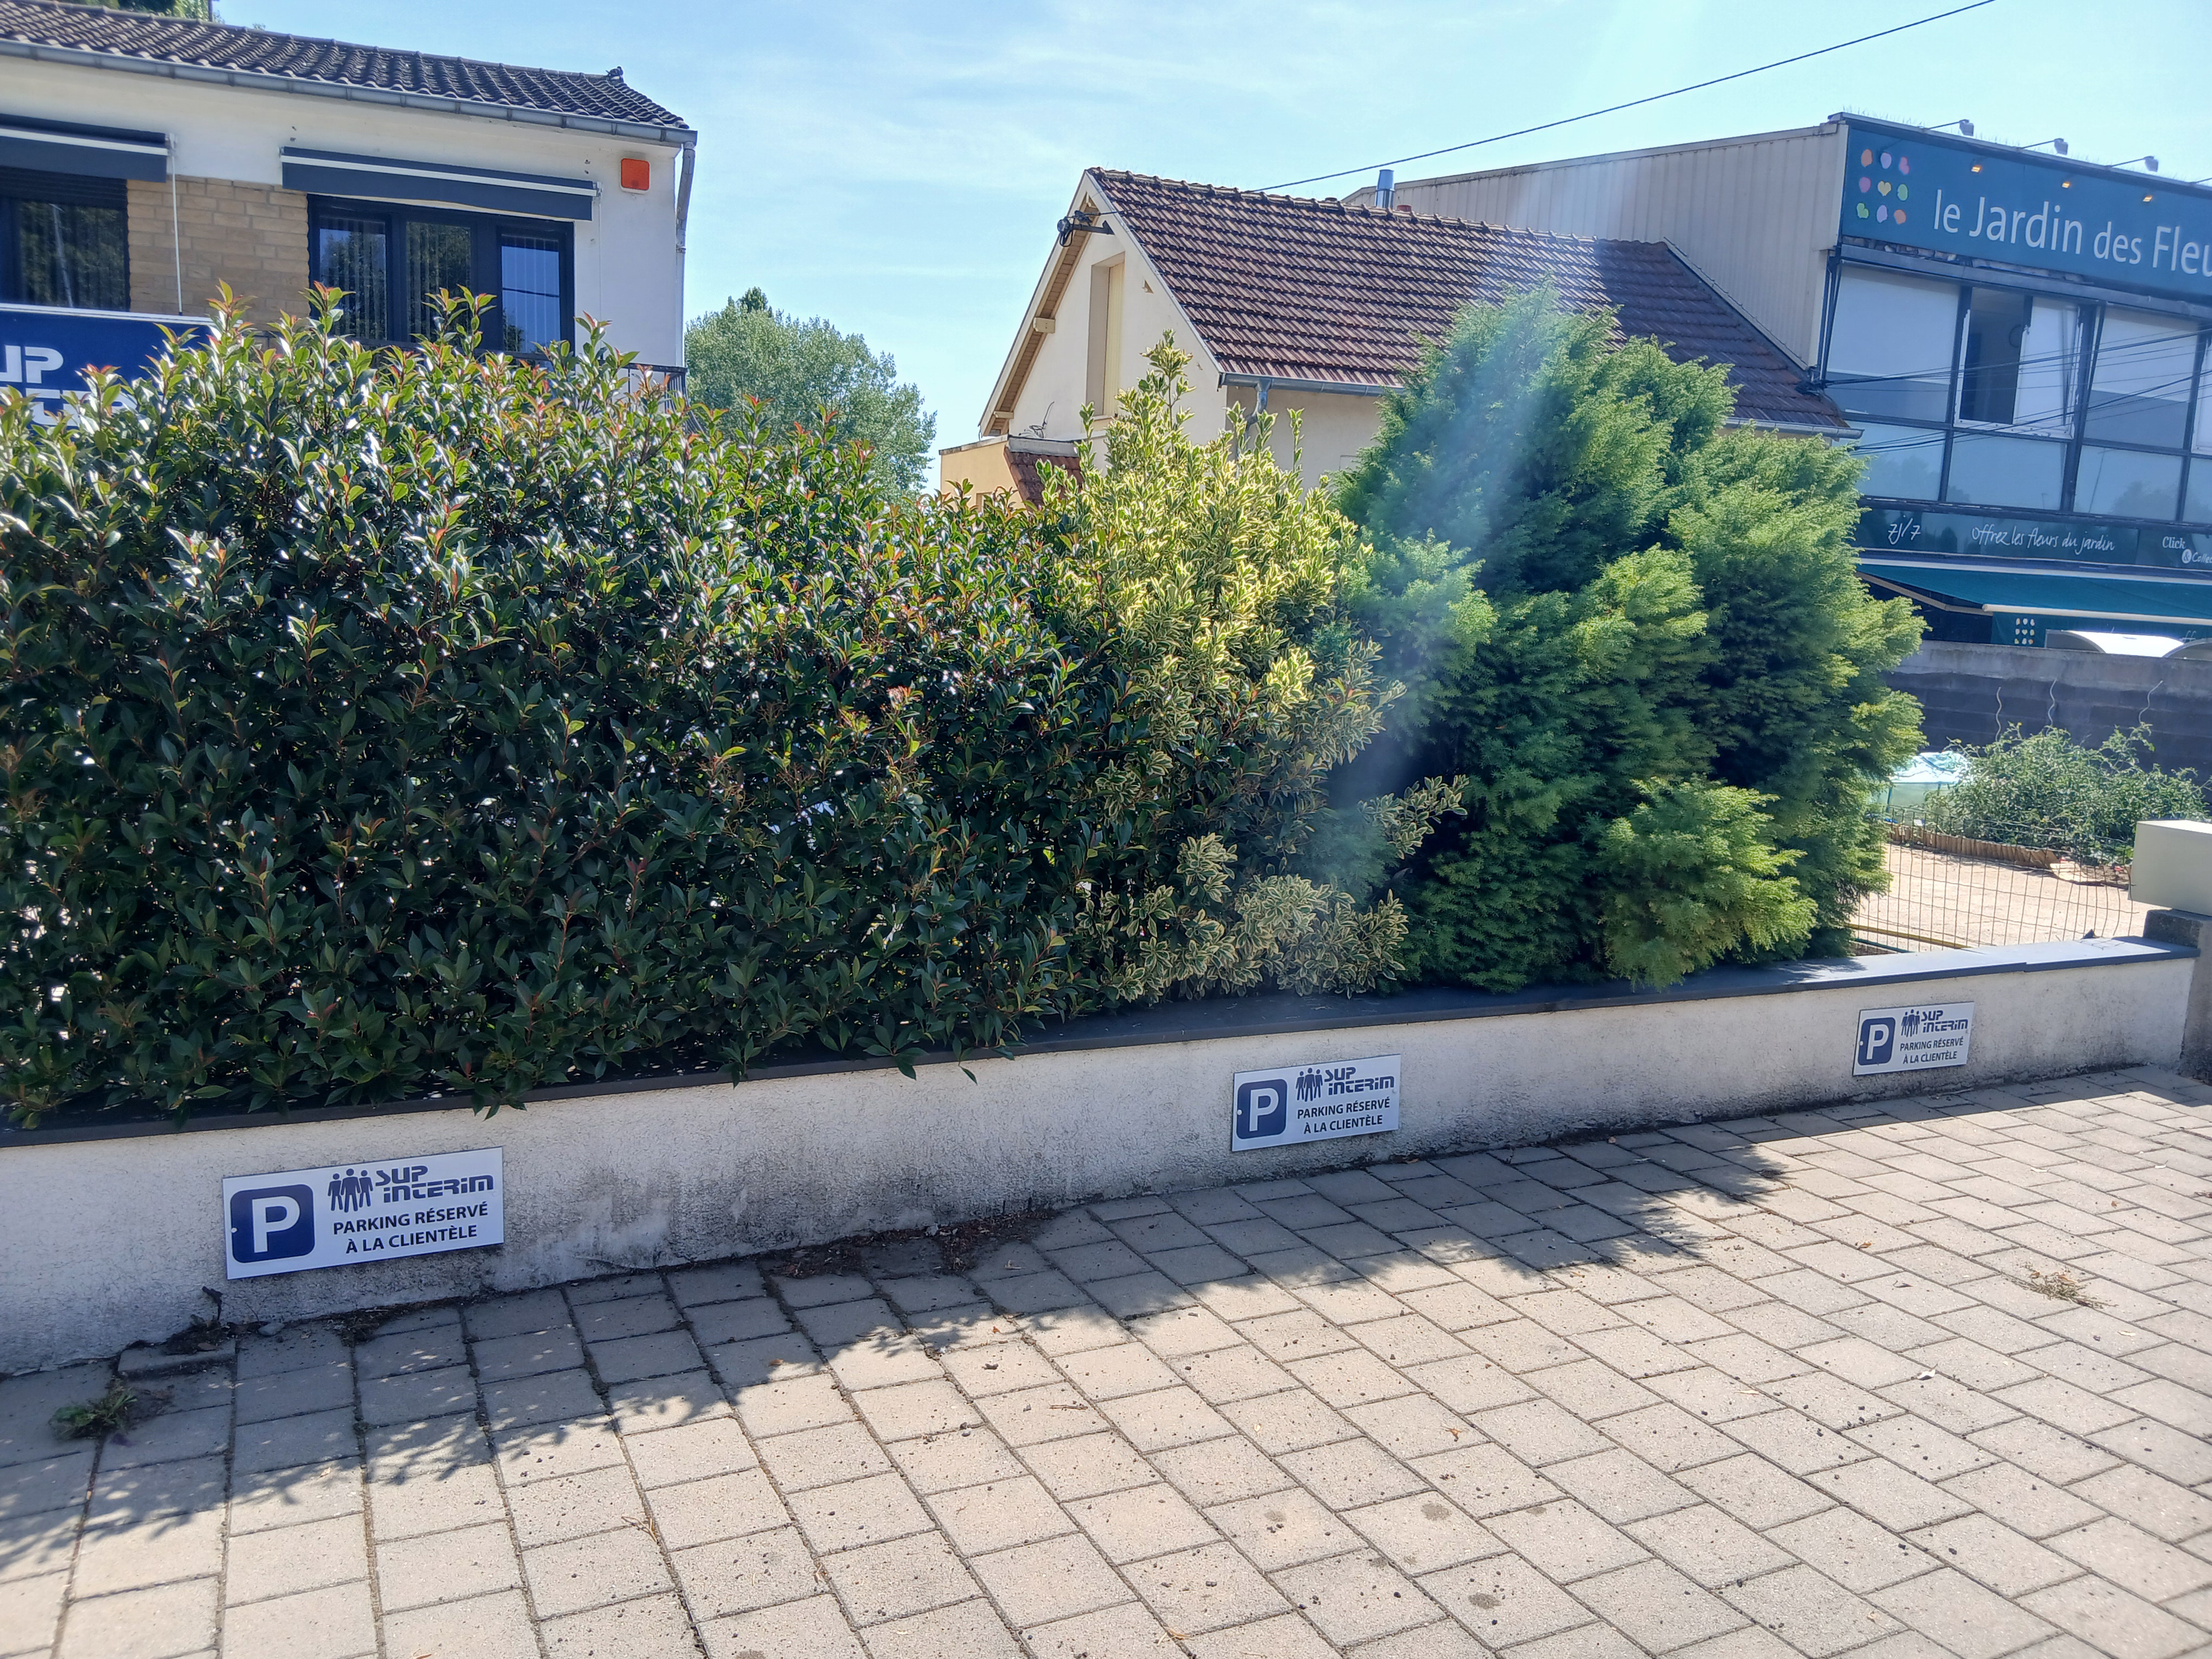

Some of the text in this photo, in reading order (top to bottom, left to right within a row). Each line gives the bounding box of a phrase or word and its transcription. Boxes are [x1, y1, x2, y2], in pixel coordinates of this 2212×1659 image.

[1934, 189, 1960, 233] le
[1969, 197, 2082, 254] Jardin
[2094, 221, 2142, 264] des
[1972, 524, 2114, 555] Offrez les fleurs du jardin
[2162, 536, 2185, 549] Click
[1921, 1010, 1943, 1022] SUP
[1866, 1024, 1889, 1059] P
[1900, 1036, 1964, 1051] PARKING RÉSERVÉ
[1903, 1050, 1957, 1064] À LA CLIENTÈLE
[1324, 1067, 1356, 1082] SUP
[1249, 1088, 1279, 1131] P
[1297, 1096, 1390, 1119] PARKING RÉSERVÉ
[1303, 1115, 1382, 1134] À LA CLIENTÈLE
[375, 1166, 428, 1186] SUP
[252, 1195, 300, 1253] P
[333, 1201, 488, 1234] PARKING RÉSERVÉ
[346, 1225, 477, 1254] À LA CLIENTÈLE
